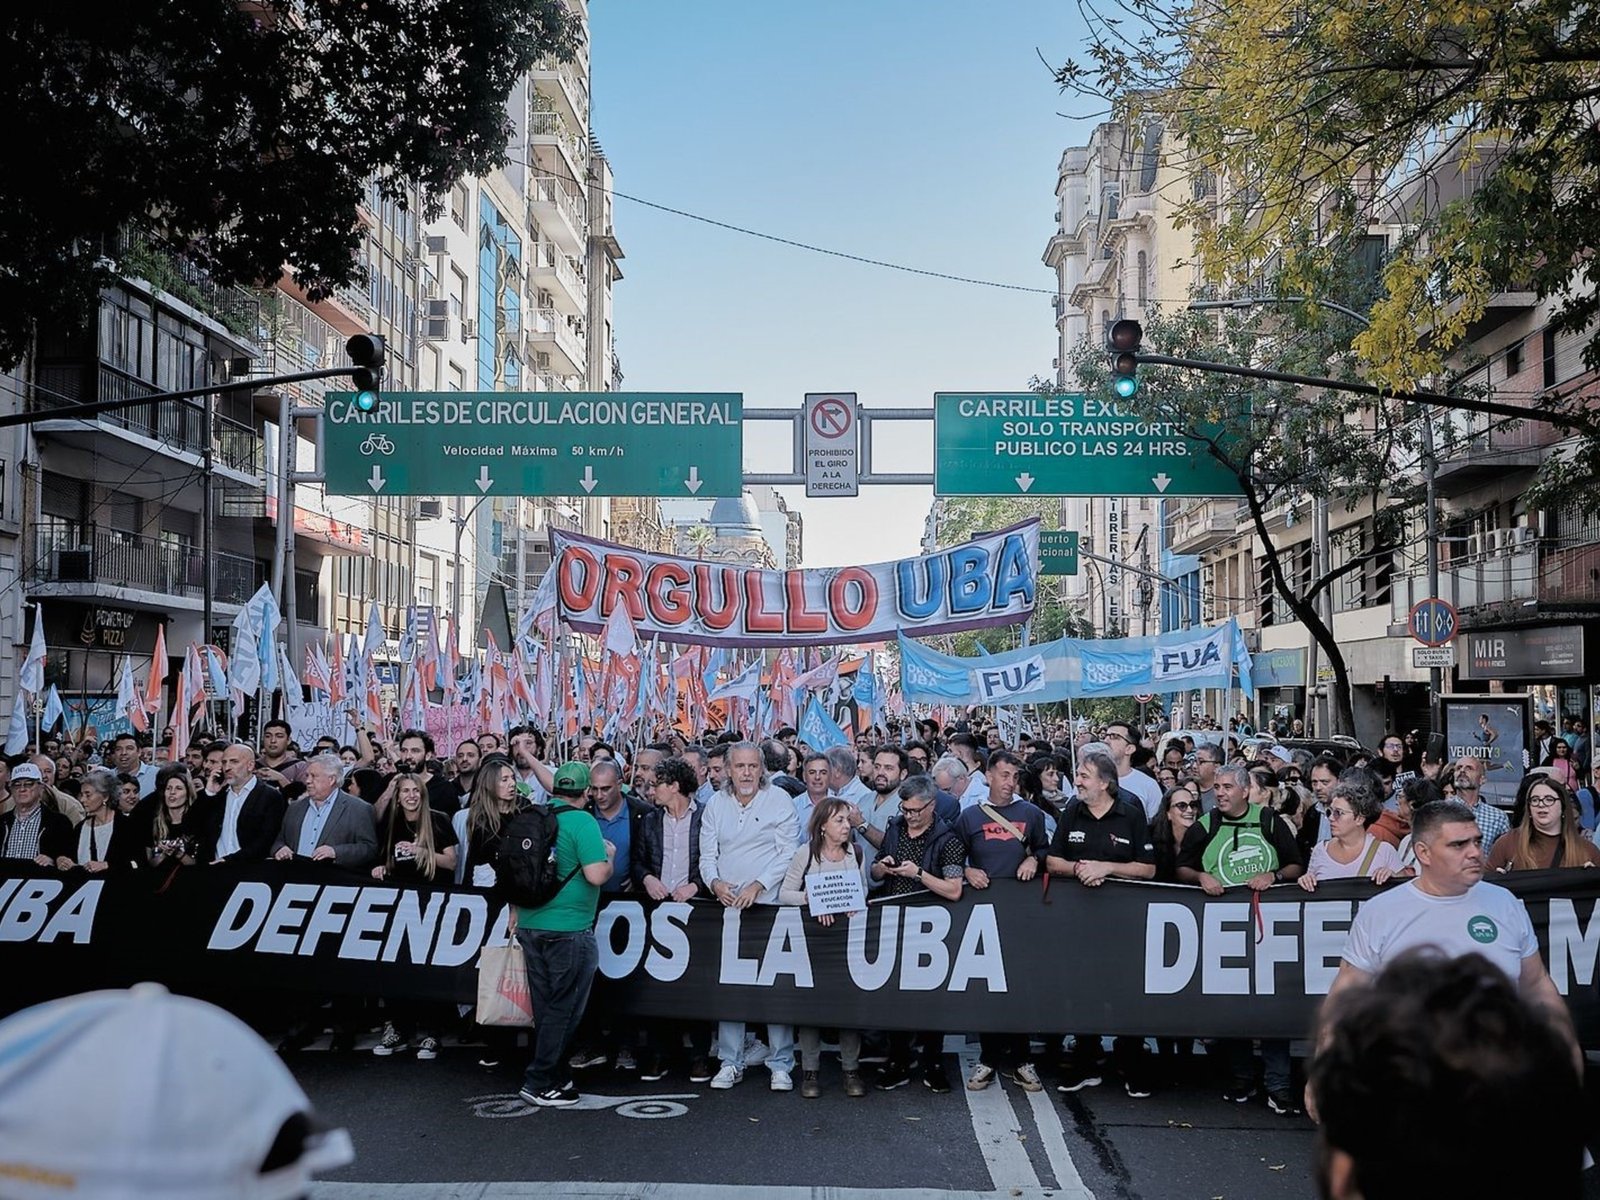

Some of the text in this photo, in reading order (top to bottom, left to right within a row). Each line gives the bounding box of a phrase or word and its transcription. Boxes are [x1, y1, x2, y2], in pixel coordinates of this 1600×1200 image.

[444, 401, 473, 424] DE
[476, 401, 630, 424] CIRCULACION
[631, 402, 738, 425] GENERAL
[959, 399, 1074, 417] CARRILES
[1003, 421, 1185, 436] SOLO TRANSPORTE
[443, 445, 624, 456] Velocidad Máxima 50 km/h
[808, 449, 854, 457] PROHIBIDO
[995, 441, 1192, 456] PUBLICO LAS 24 HRS.
[815, 460, 848, 468] EL GIRO
[812, 482, 852, 490] DERECHA
[1039, 533, 1069, 544] uerto
[558, 534, 1035, 633] ORGULLO UBA
[103, 629, 125, 645] PIZZA
[1162, 641, 1221, 673] FUA
[1087, 662, 1149, 674] ORGULLO
[907, 672, 938, 687] UBA
[1450, 746, 1500, 758] VELOCITY 3
[1231, 863, 1265, 877] APUBA
[812, 888, 850, 897] UNIVERSIDAD
[207, 882, 694, 982] DEFENDOS
[719, 905, 814, 988] LA
[847, 904, 1008, 992] UBA
